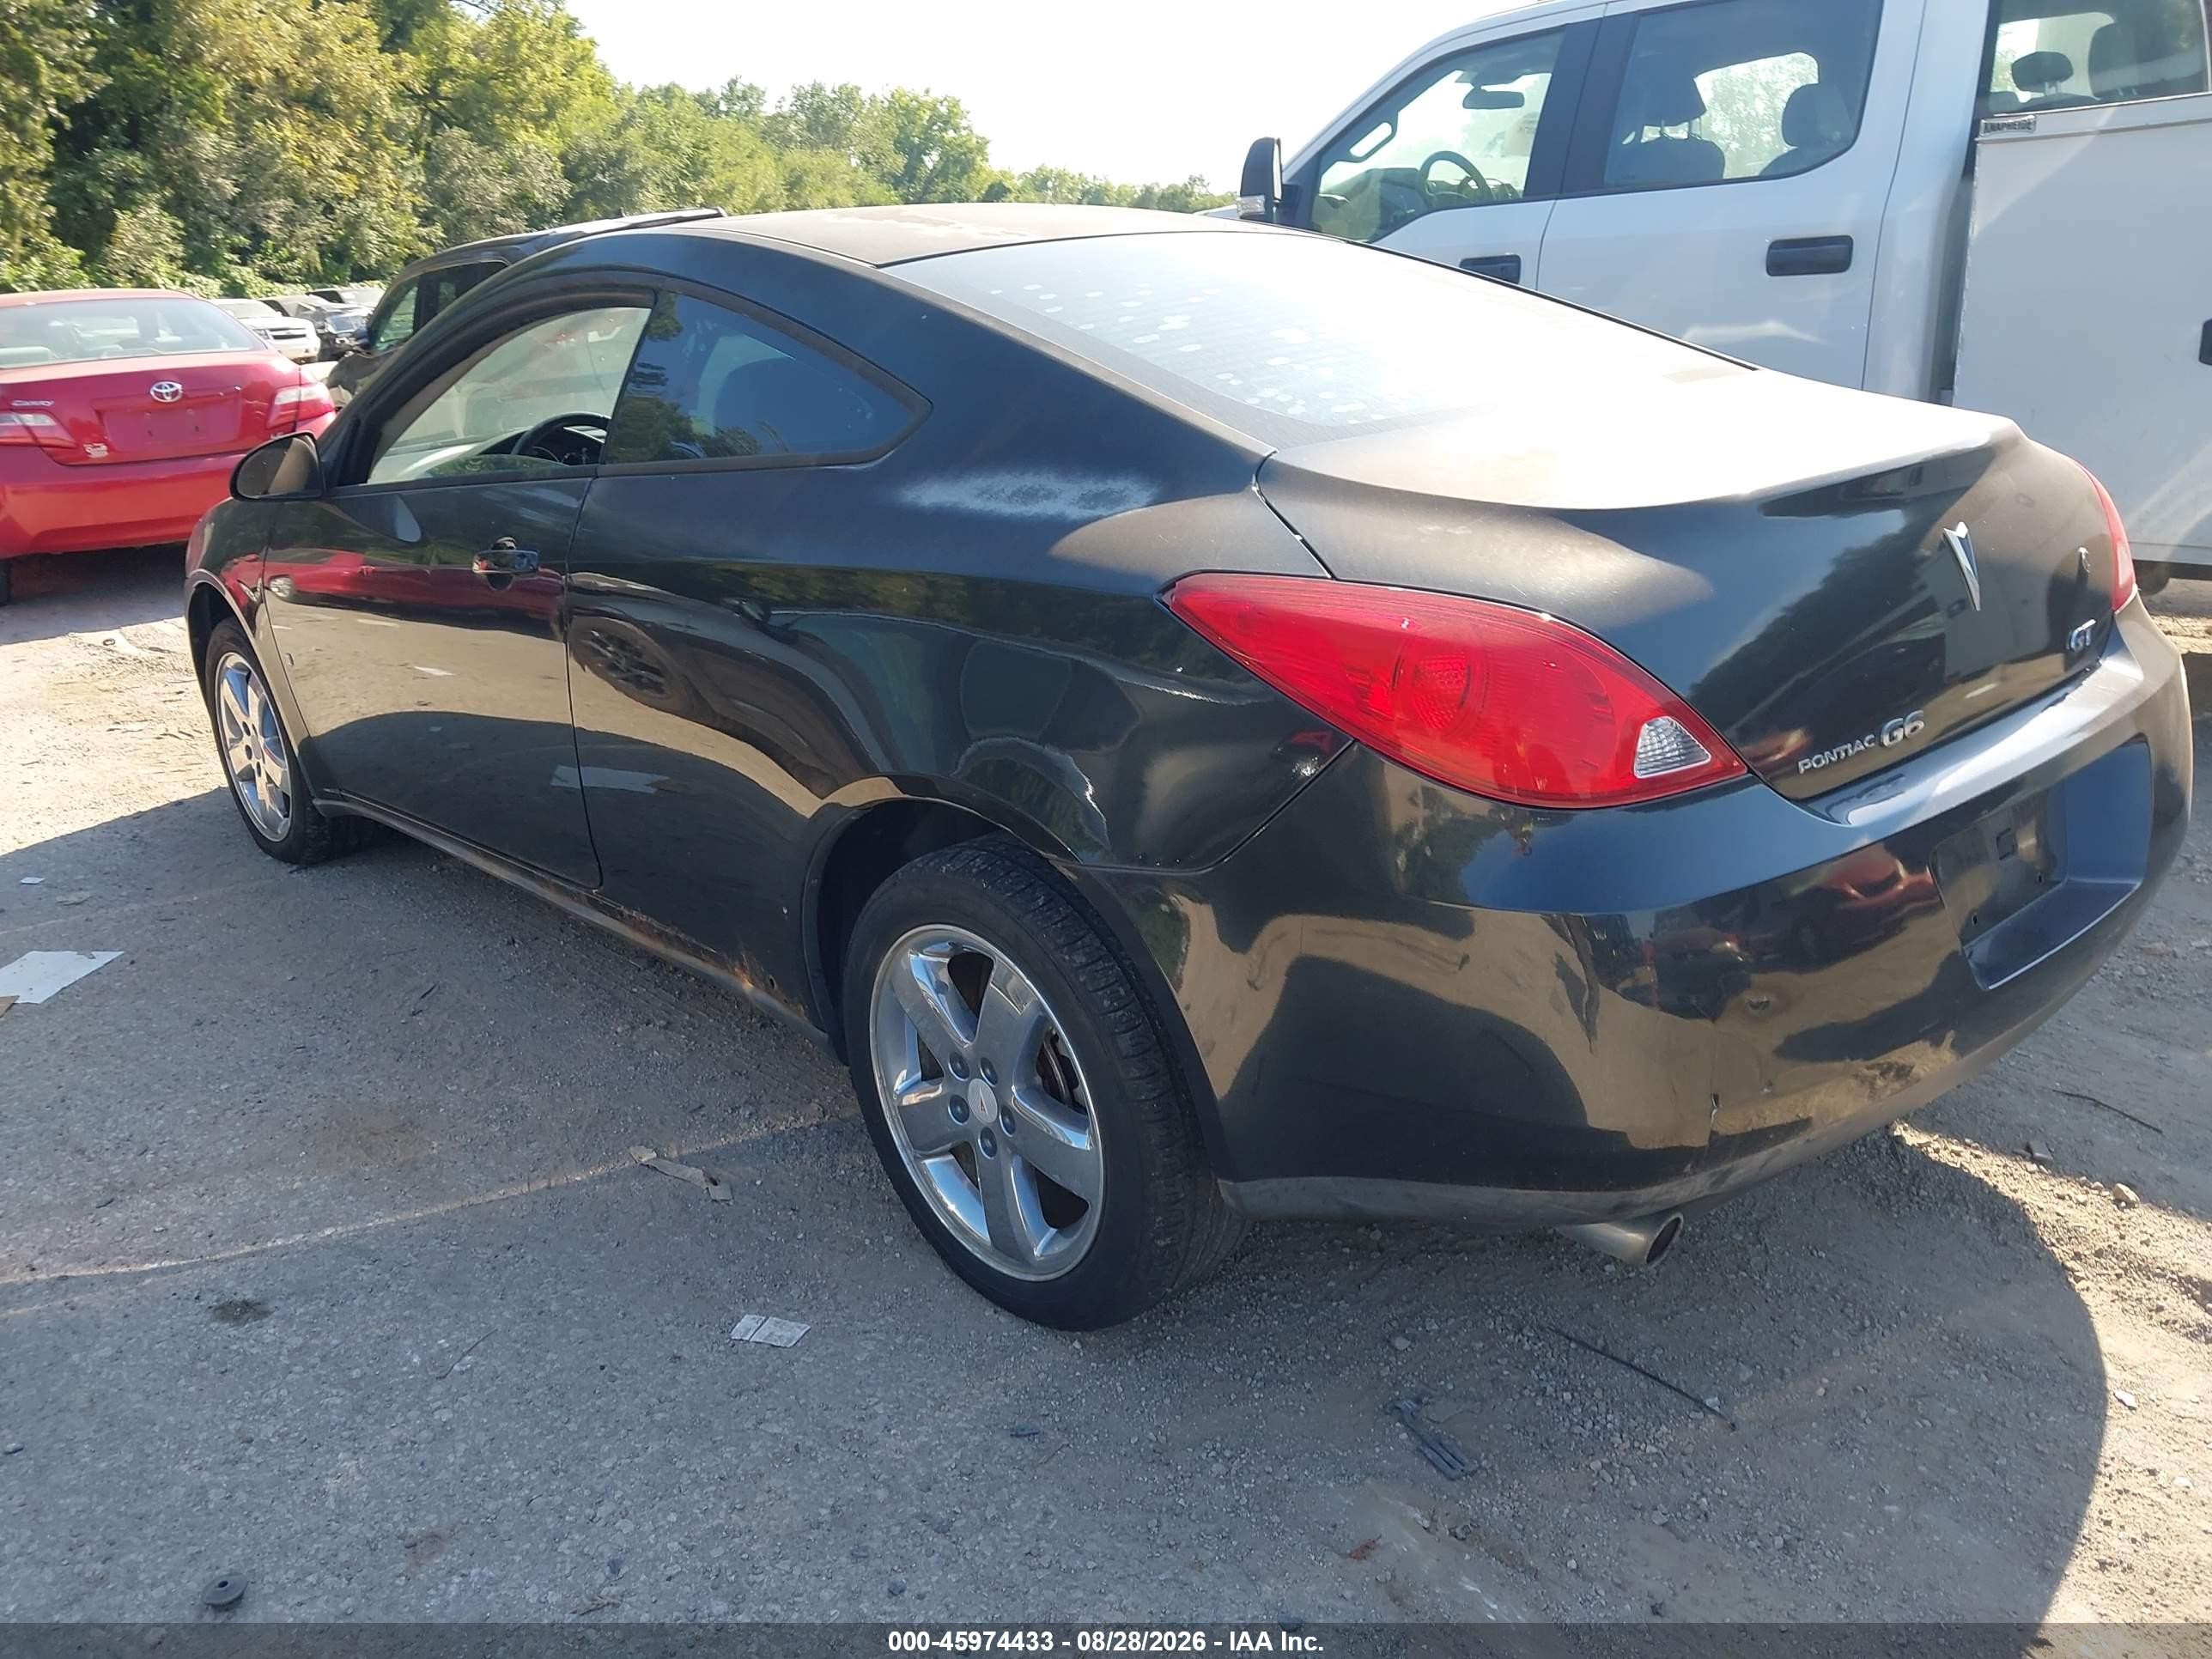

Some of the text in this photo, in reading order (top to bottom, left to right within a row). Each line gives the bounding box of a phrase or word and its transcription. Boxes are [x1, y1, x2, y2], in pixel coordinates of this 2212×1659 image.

[2066, 619, 2096, 652] GT
[1797, 709, 1925, 775] PONTIAC G6
